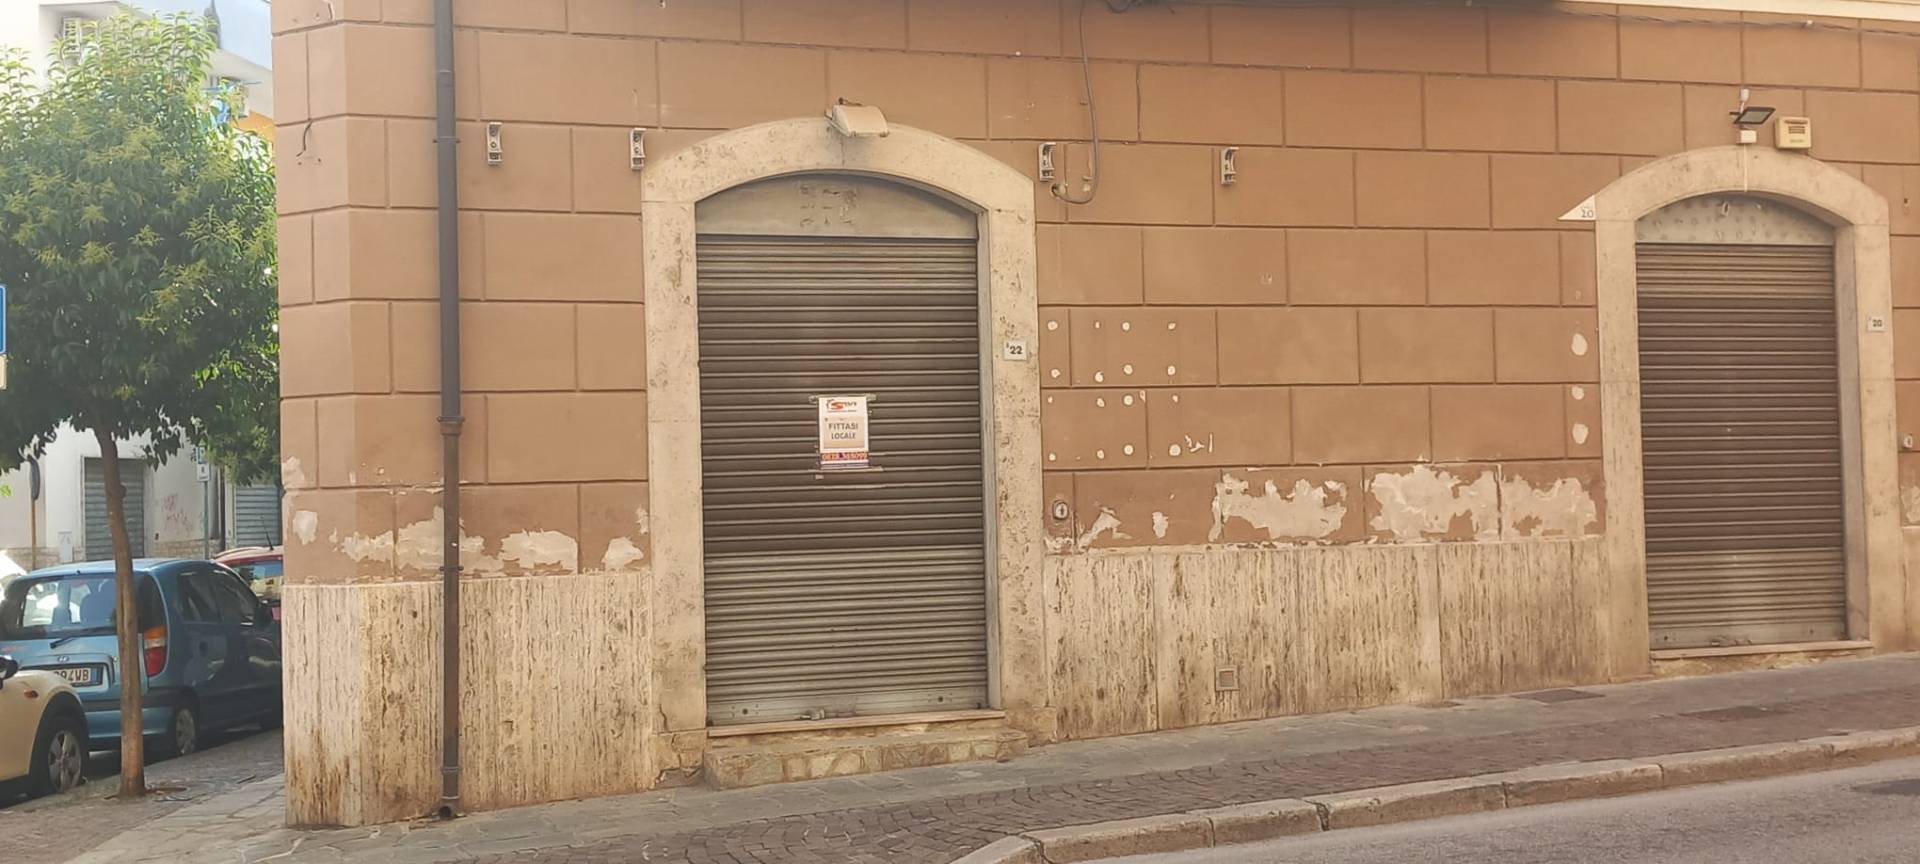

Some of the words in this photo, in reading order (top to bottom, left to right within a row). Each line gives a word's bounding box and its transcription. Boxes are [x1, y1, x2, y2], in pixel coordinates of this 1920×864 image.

[1872, 318, 1883, 328] 20
[1009, 345, 1023, 355] 22
[828, 422, 859, 430] FITTASI
[831, 432, 857, 440] LOCALE
